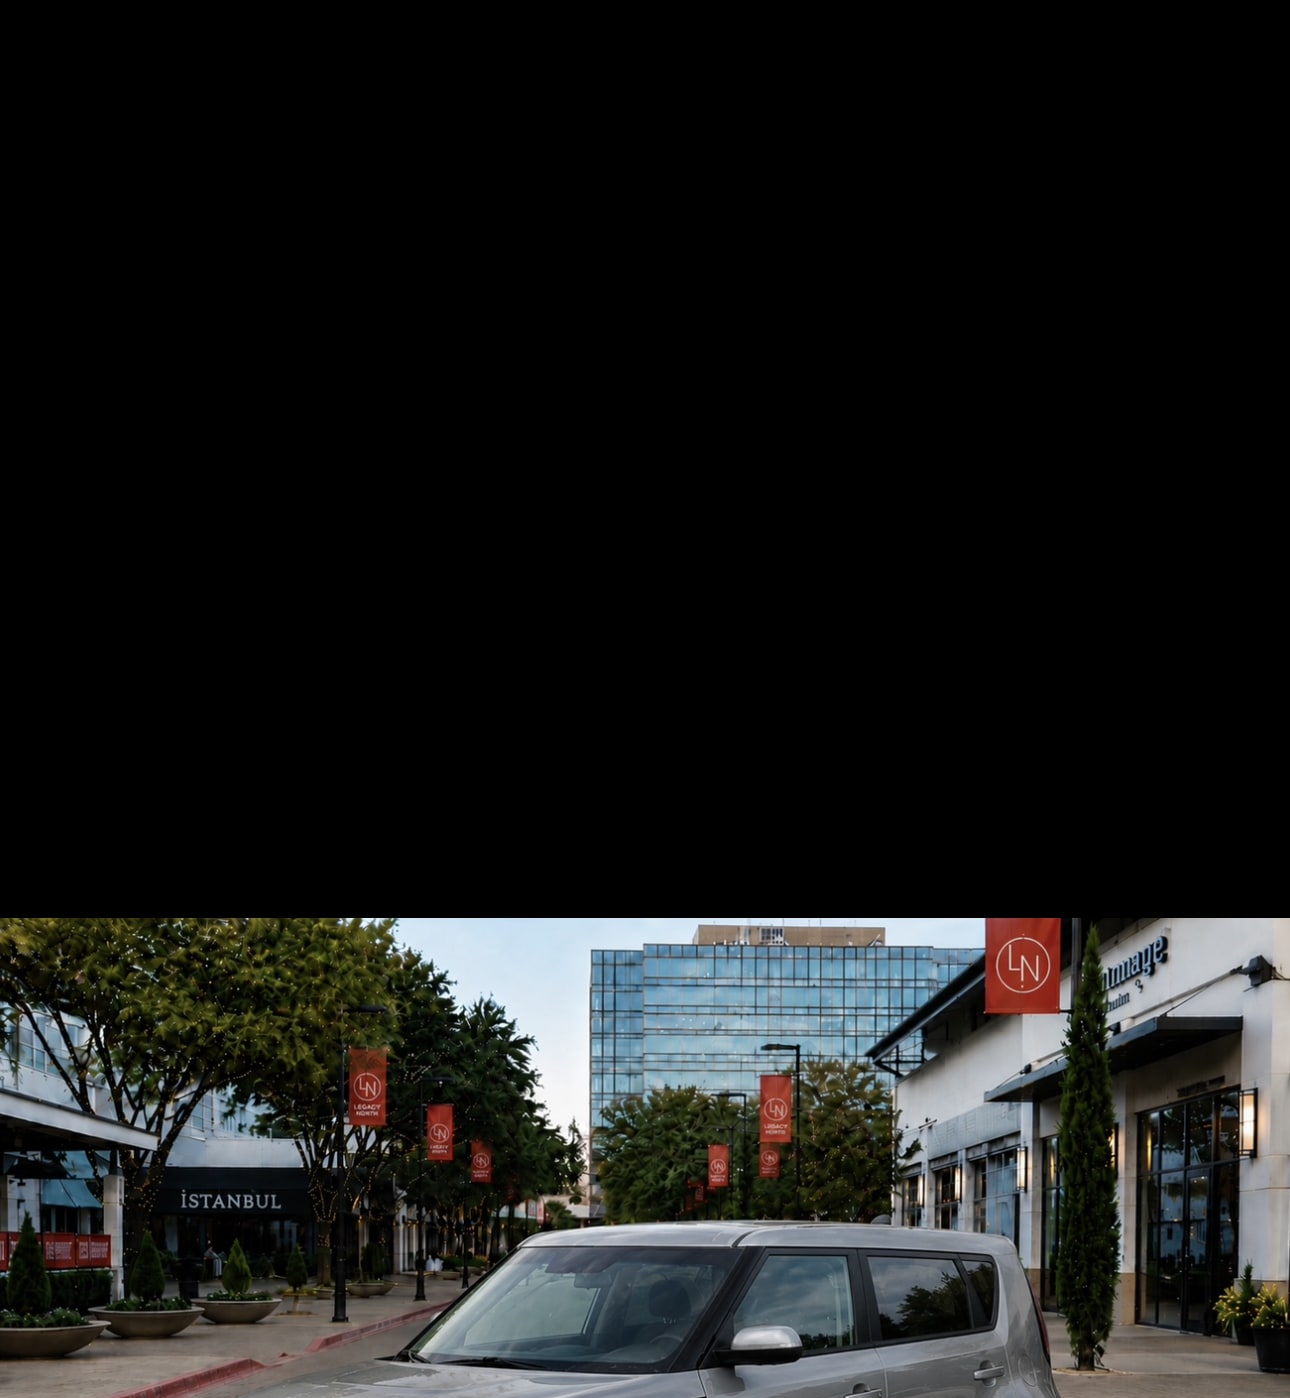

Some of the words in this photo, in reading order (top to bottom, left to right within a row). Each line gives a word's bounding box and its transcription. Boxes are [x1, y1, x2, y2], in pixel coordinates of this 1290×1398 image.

[1008, 943, 1040, 982] LN
[359, 1077, 377, 1098] LN
[353, 1103, 381, 1111] LEGACY
[769, 1100, 785, 1118] LN
[181, 1188, 282, 1209] İSTANBUL
